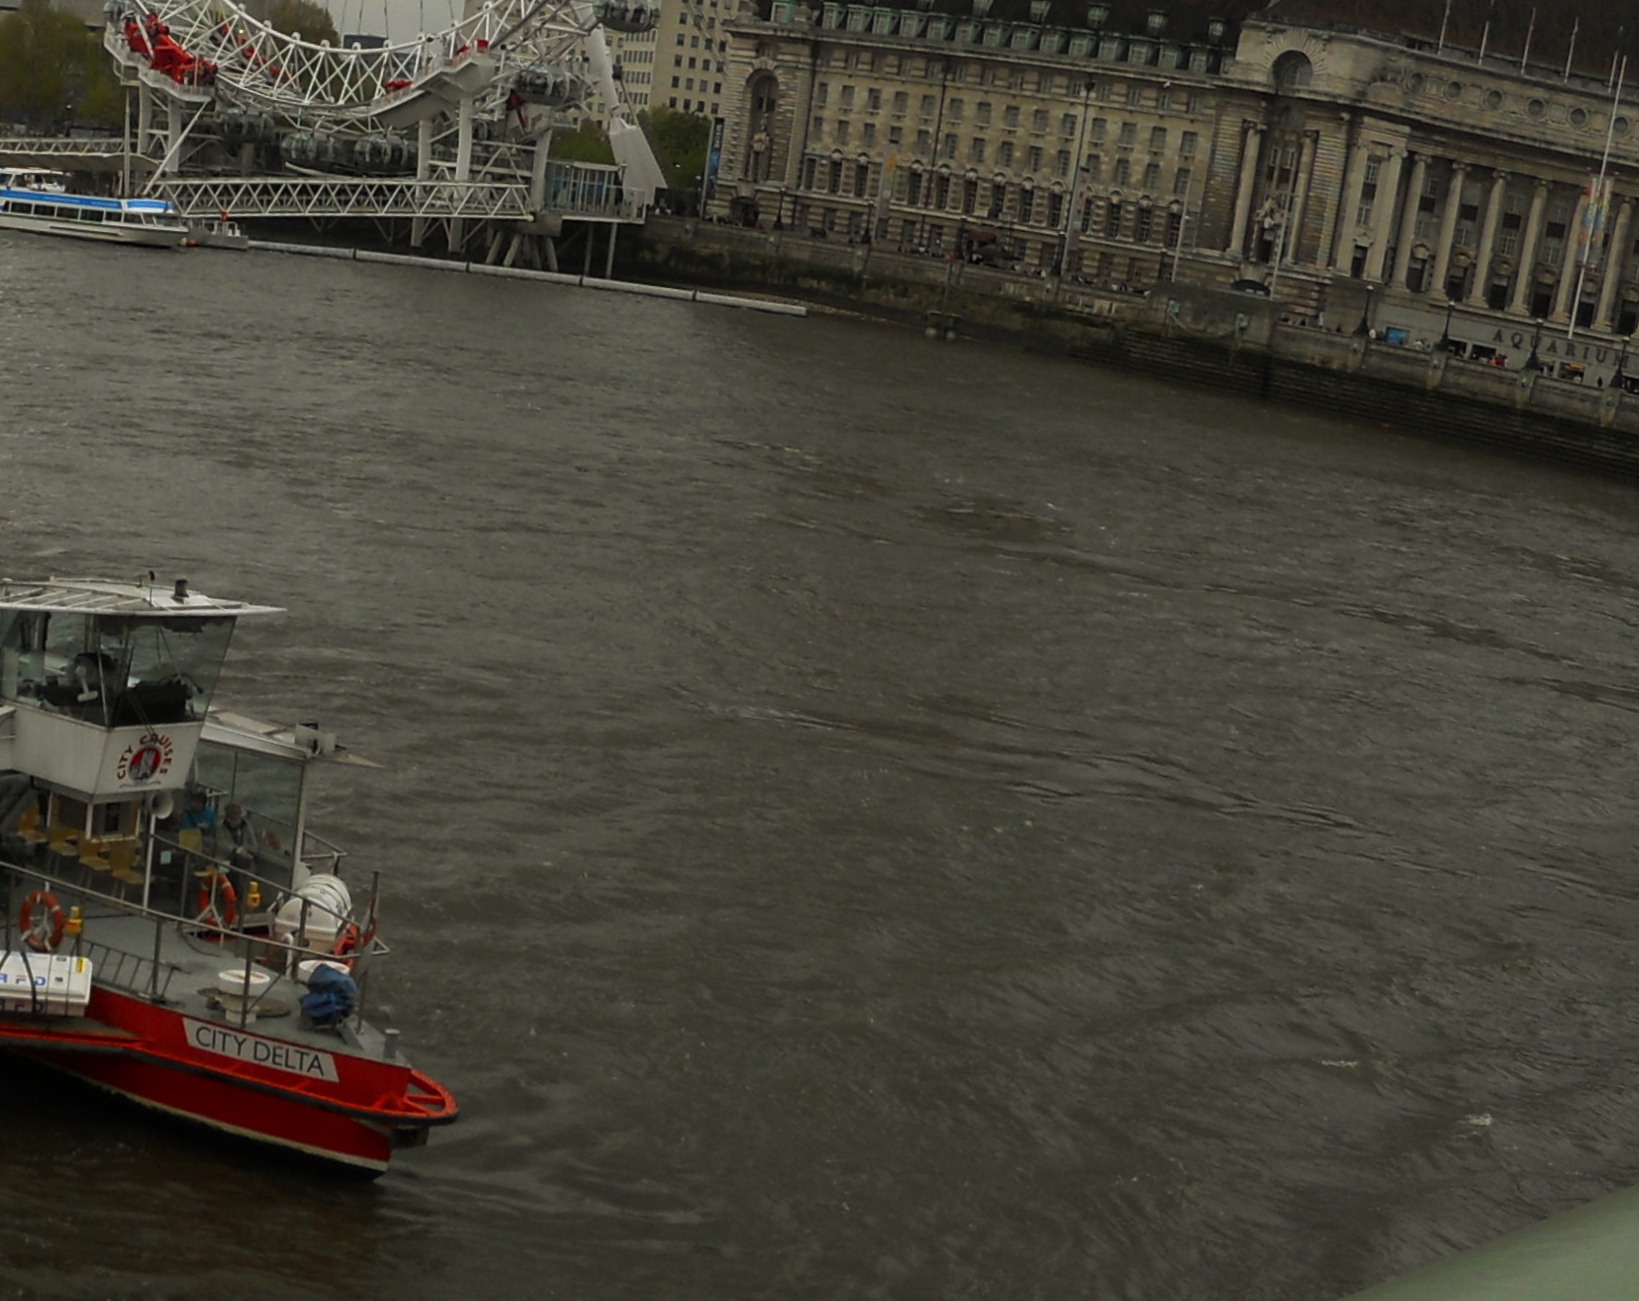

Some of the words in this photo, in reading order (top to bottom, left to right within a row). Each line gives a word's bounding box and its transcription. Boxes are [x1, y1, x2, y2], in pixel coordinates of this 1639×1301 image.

[1492, 329, 1631, 369] AQUARIUM
[117, 744, 134, 780] CITY
[139, 732, 174, 775] CRUISES
[195, 1026, 247, 1057] CITY
[252, 1040, 325, 1078] DELTA
